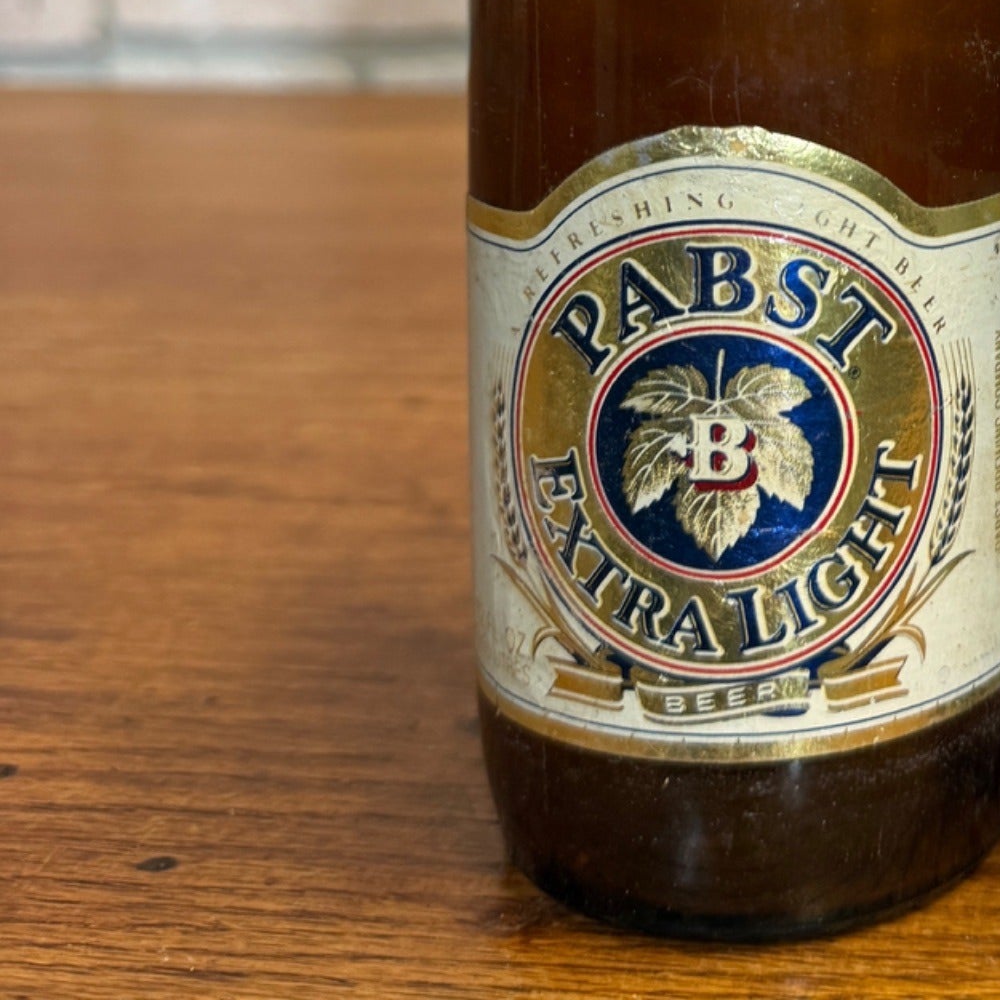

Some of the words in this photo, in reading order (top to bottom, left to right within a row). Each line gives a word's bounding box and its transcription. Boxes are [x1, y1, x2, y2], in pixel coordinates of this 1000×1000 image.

[523, 192, 735, 303] REFRESHING
[550, 242, 897, 376] PABST
[690, 414, 757, 491] B
[530, 446, 724, 657] EXTRA
[726, 439, 924, 657] LIGHT
[664, 682, 776, 713] BEER
